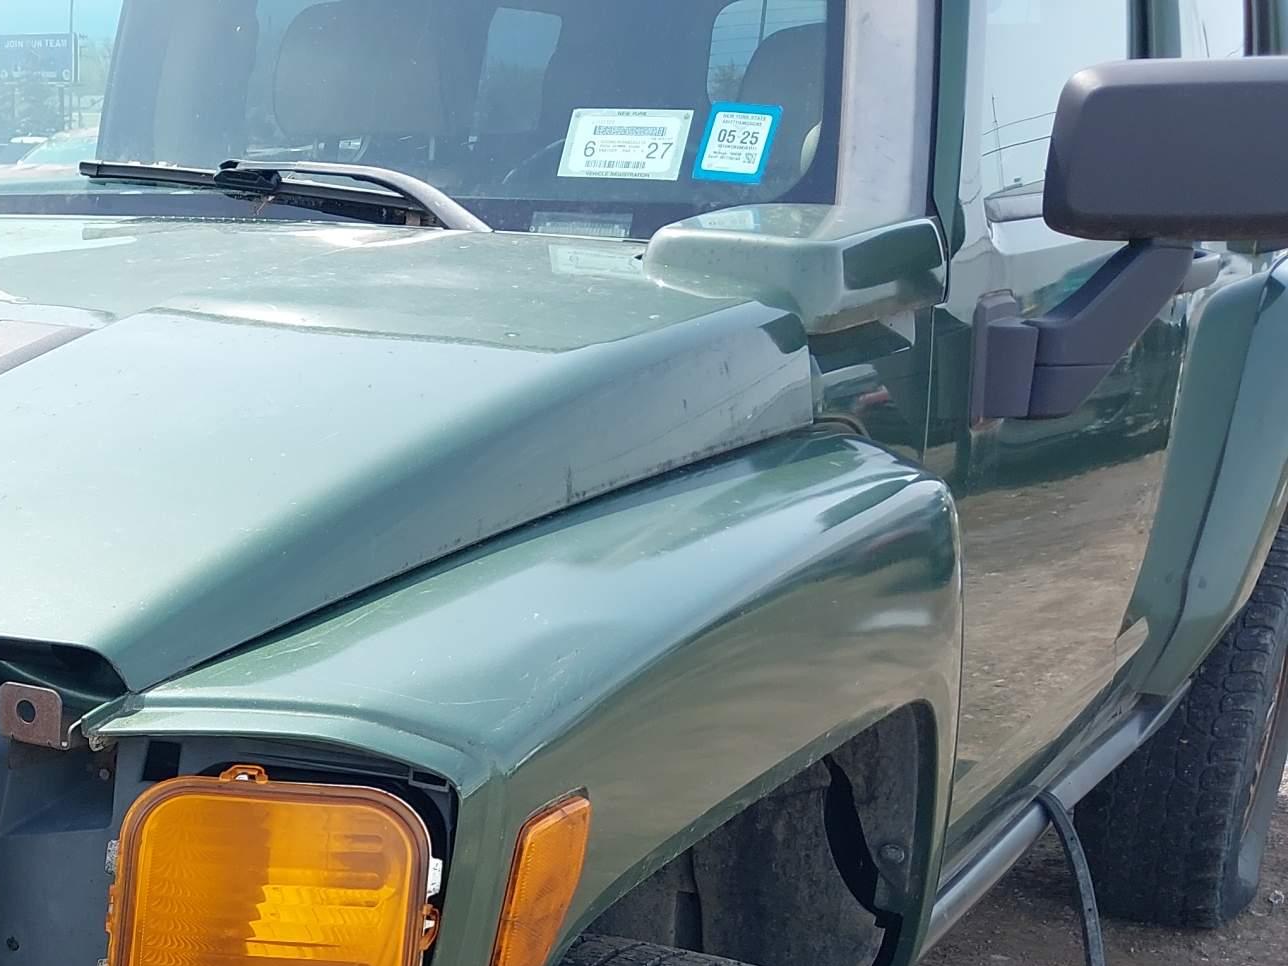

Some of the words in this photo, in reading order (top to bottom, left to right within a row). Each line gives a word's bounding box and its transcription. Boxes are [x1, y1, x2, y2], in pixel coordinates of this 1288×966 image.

[717, 128, 738, 144] 05
[739, 130, 761, 146] 25
[583, 139, 597, 158] 6
[645, 141, 675, 160] 27
